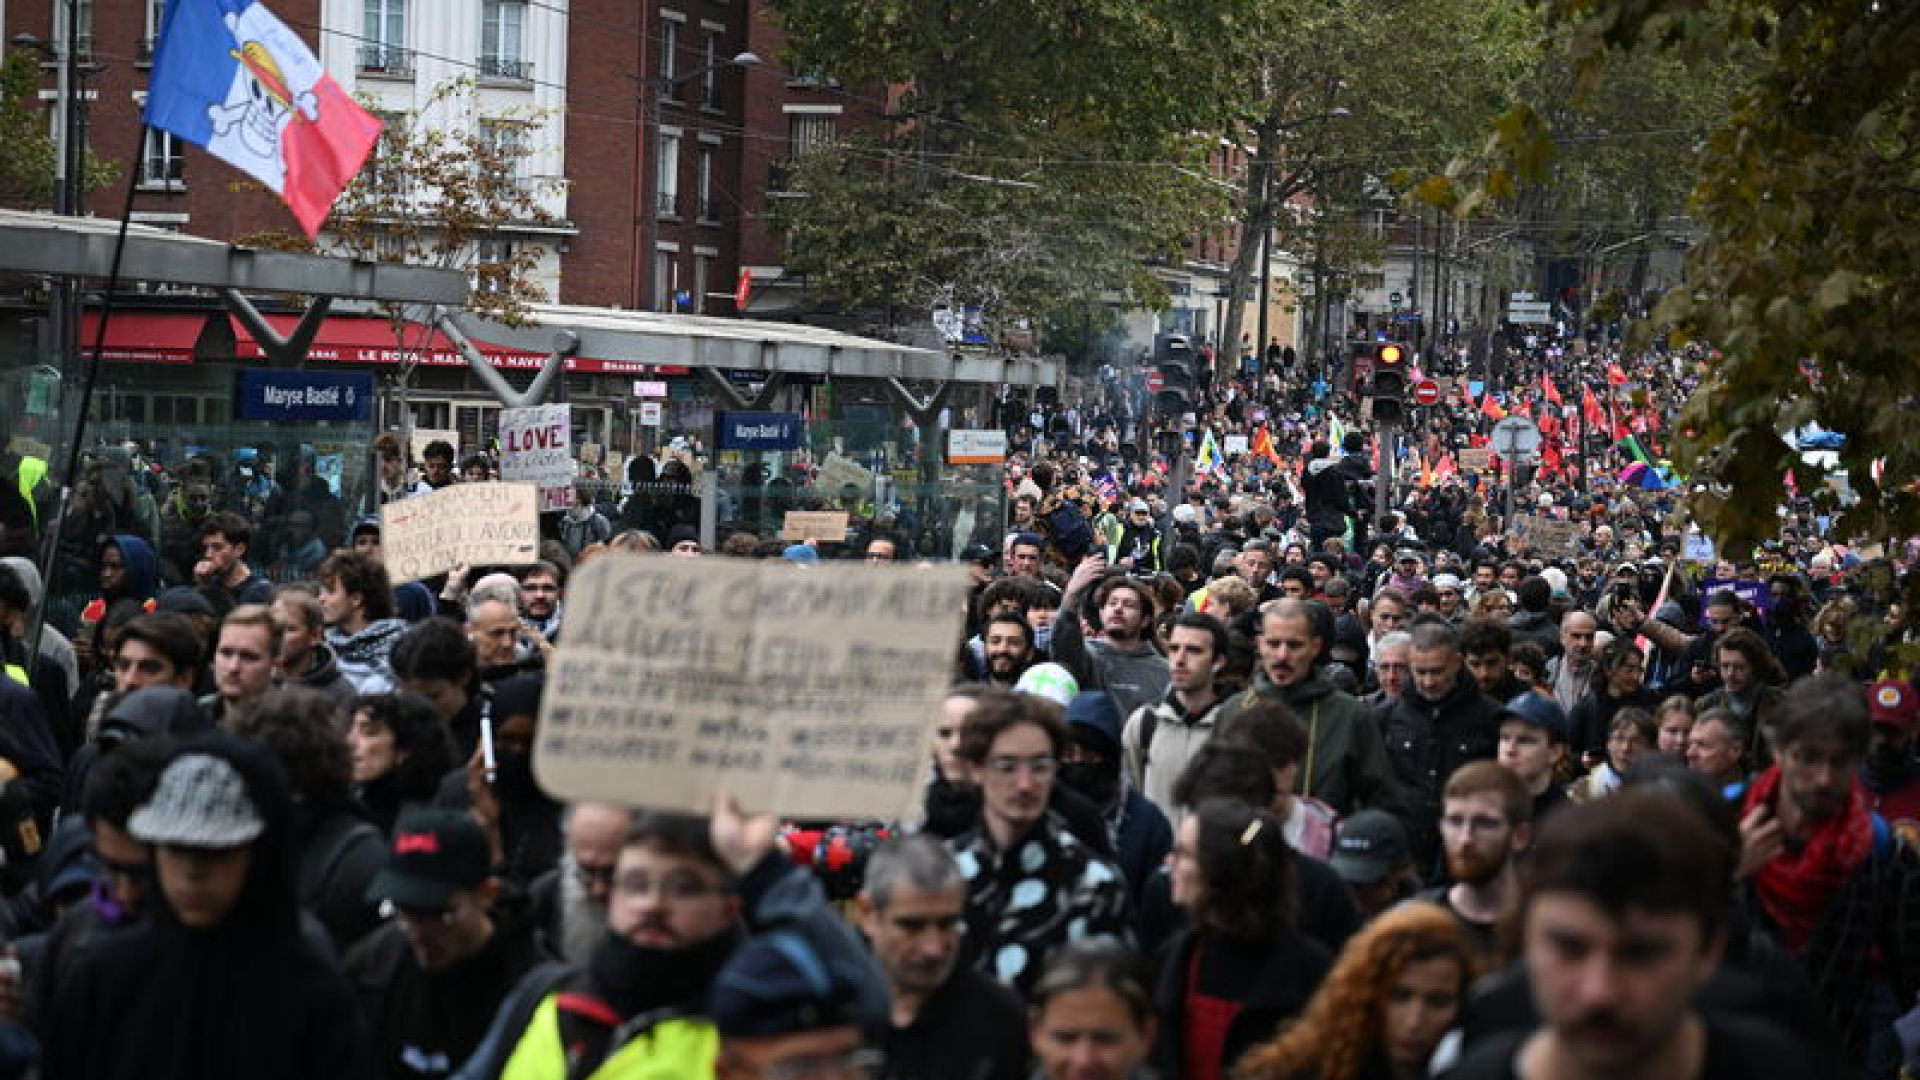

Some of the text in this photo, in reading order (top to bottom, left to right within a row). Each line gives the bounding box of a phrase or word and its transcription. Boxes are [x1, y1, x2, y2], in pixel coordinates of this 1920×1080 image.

[357, 350, 377, 361] LE
[264, 385, 339, 408] Maryse Bastié
[508, 424, 564, 452] LOVE
